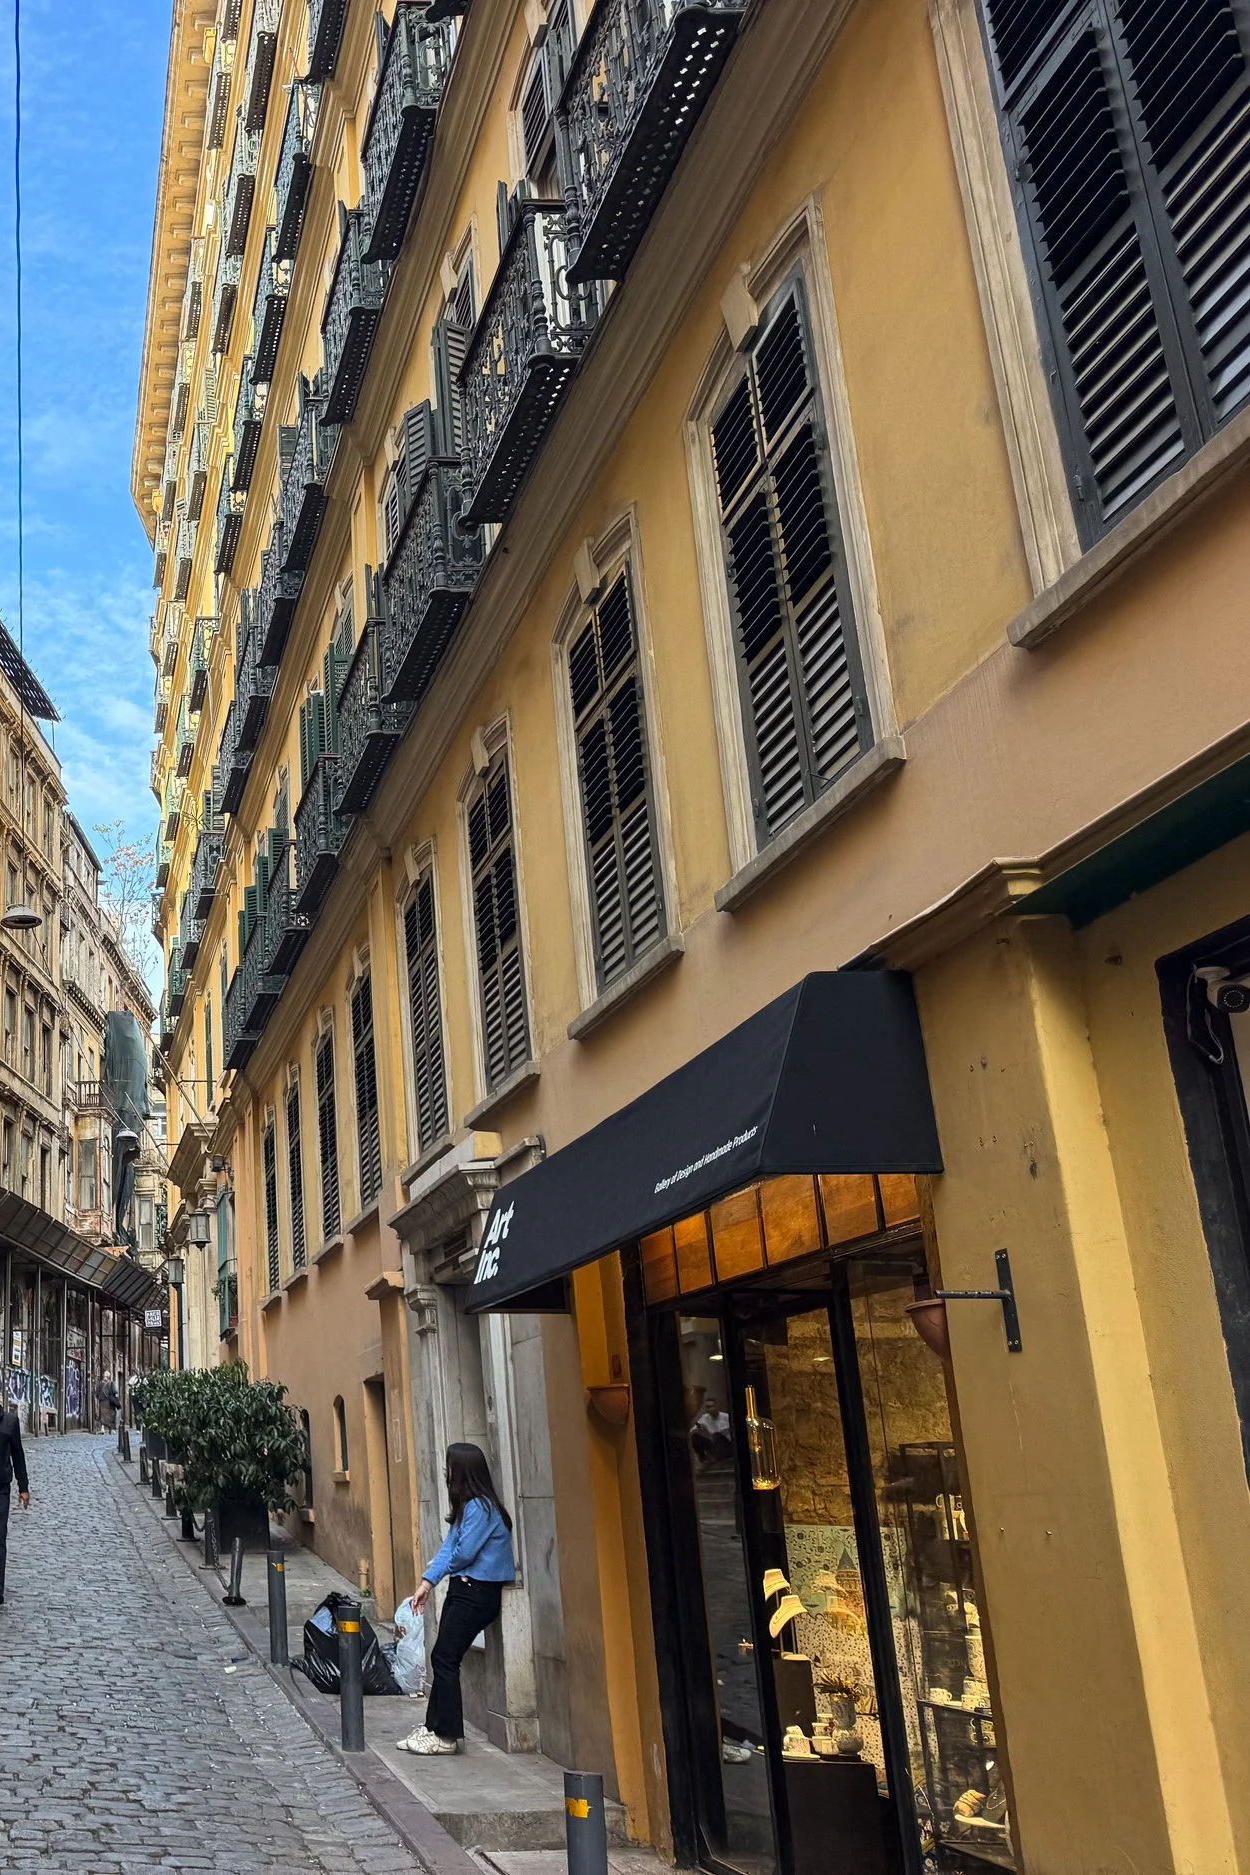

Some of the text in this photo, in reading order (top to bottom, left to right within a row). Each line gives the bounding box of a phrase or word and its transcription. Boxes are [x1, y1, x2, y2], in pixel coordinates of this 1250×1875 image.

[654, 1179, 671, 1194] Gallery
[676, 1165, 694, 1181] Design
[693, 1155, 705, 1172] and
[703, 1140, 733, 1166] Handmade
[732, 1126, 758, 1148] Products
[483, 1200, 515, 1249] Art
[474, 1246, 500, 1285] Inc.
